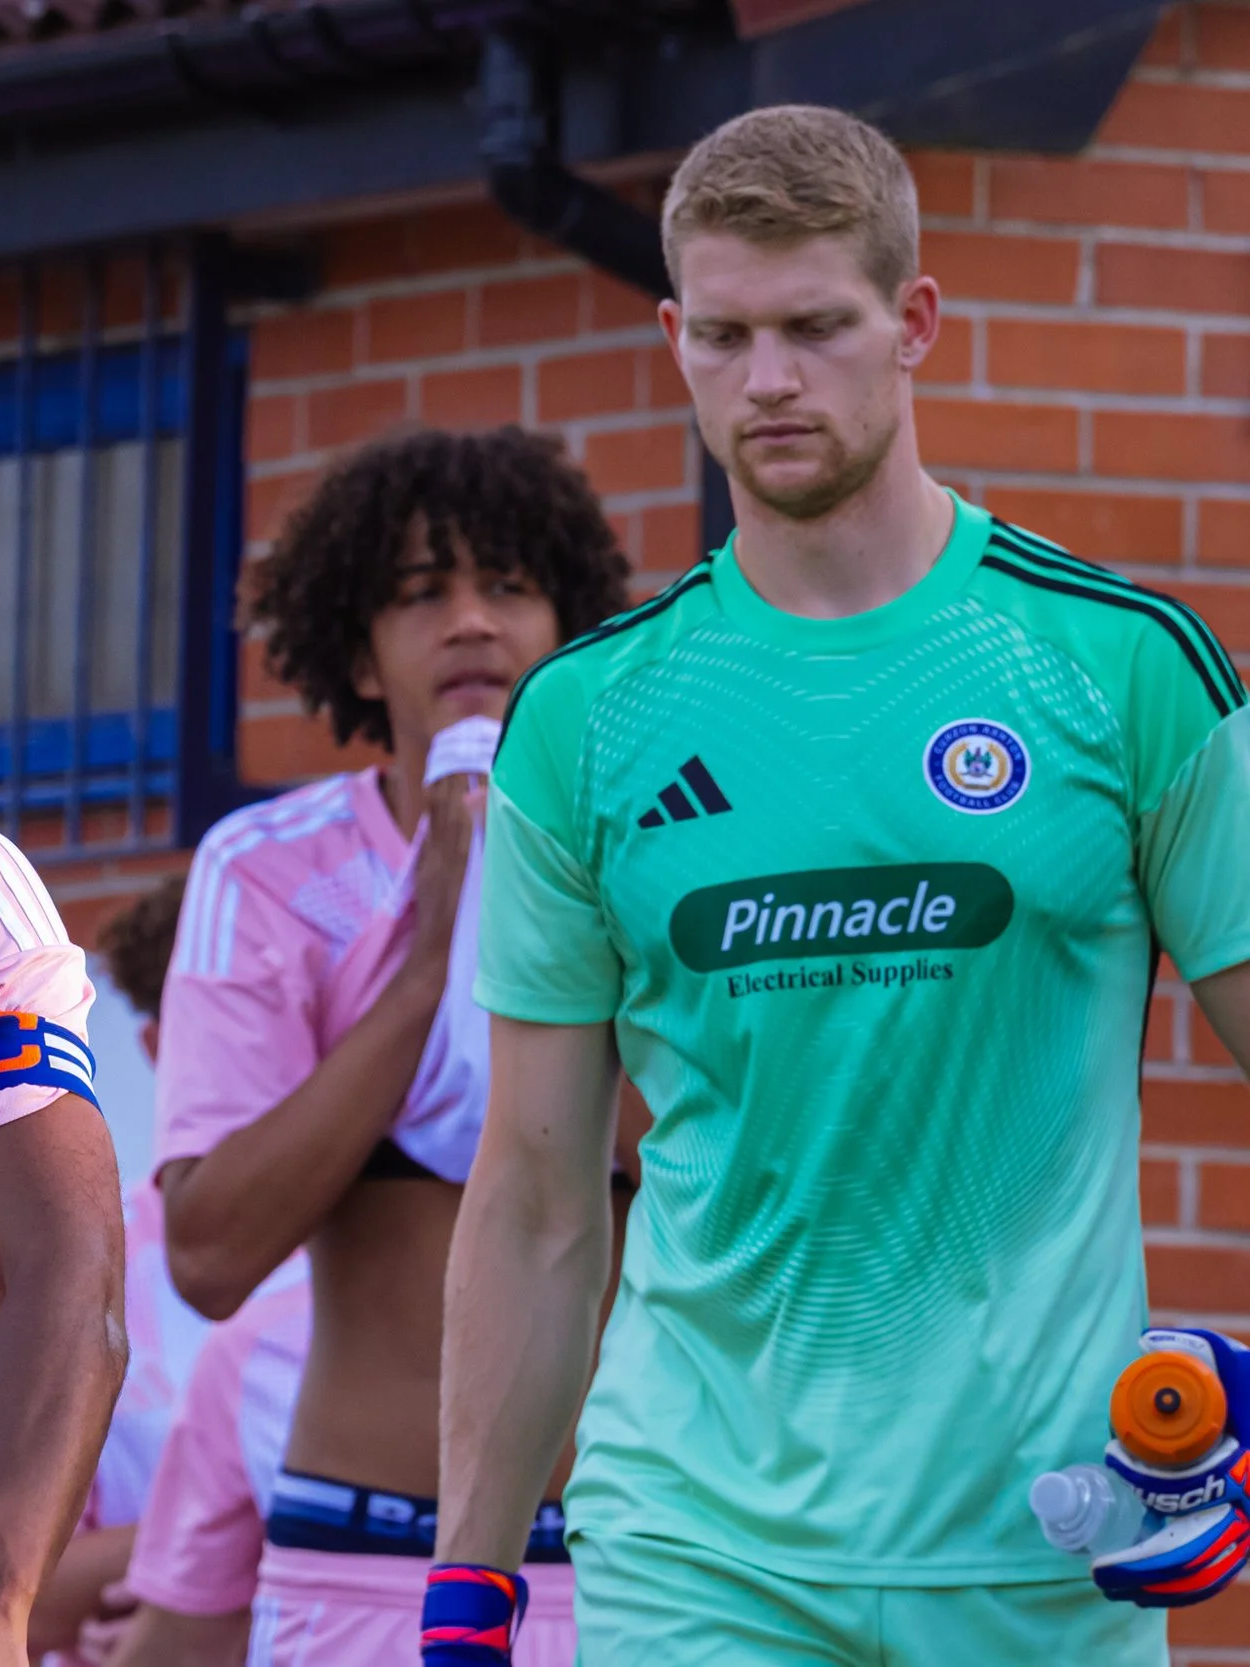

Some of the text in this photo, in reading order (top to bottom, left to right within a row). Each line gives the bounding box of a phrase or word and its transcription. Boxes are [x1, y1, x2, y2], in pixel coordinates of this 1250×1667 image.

[721, 880, 956, 952] Pinnacle
[727, 958, 954, 999] Electrical Supplies
